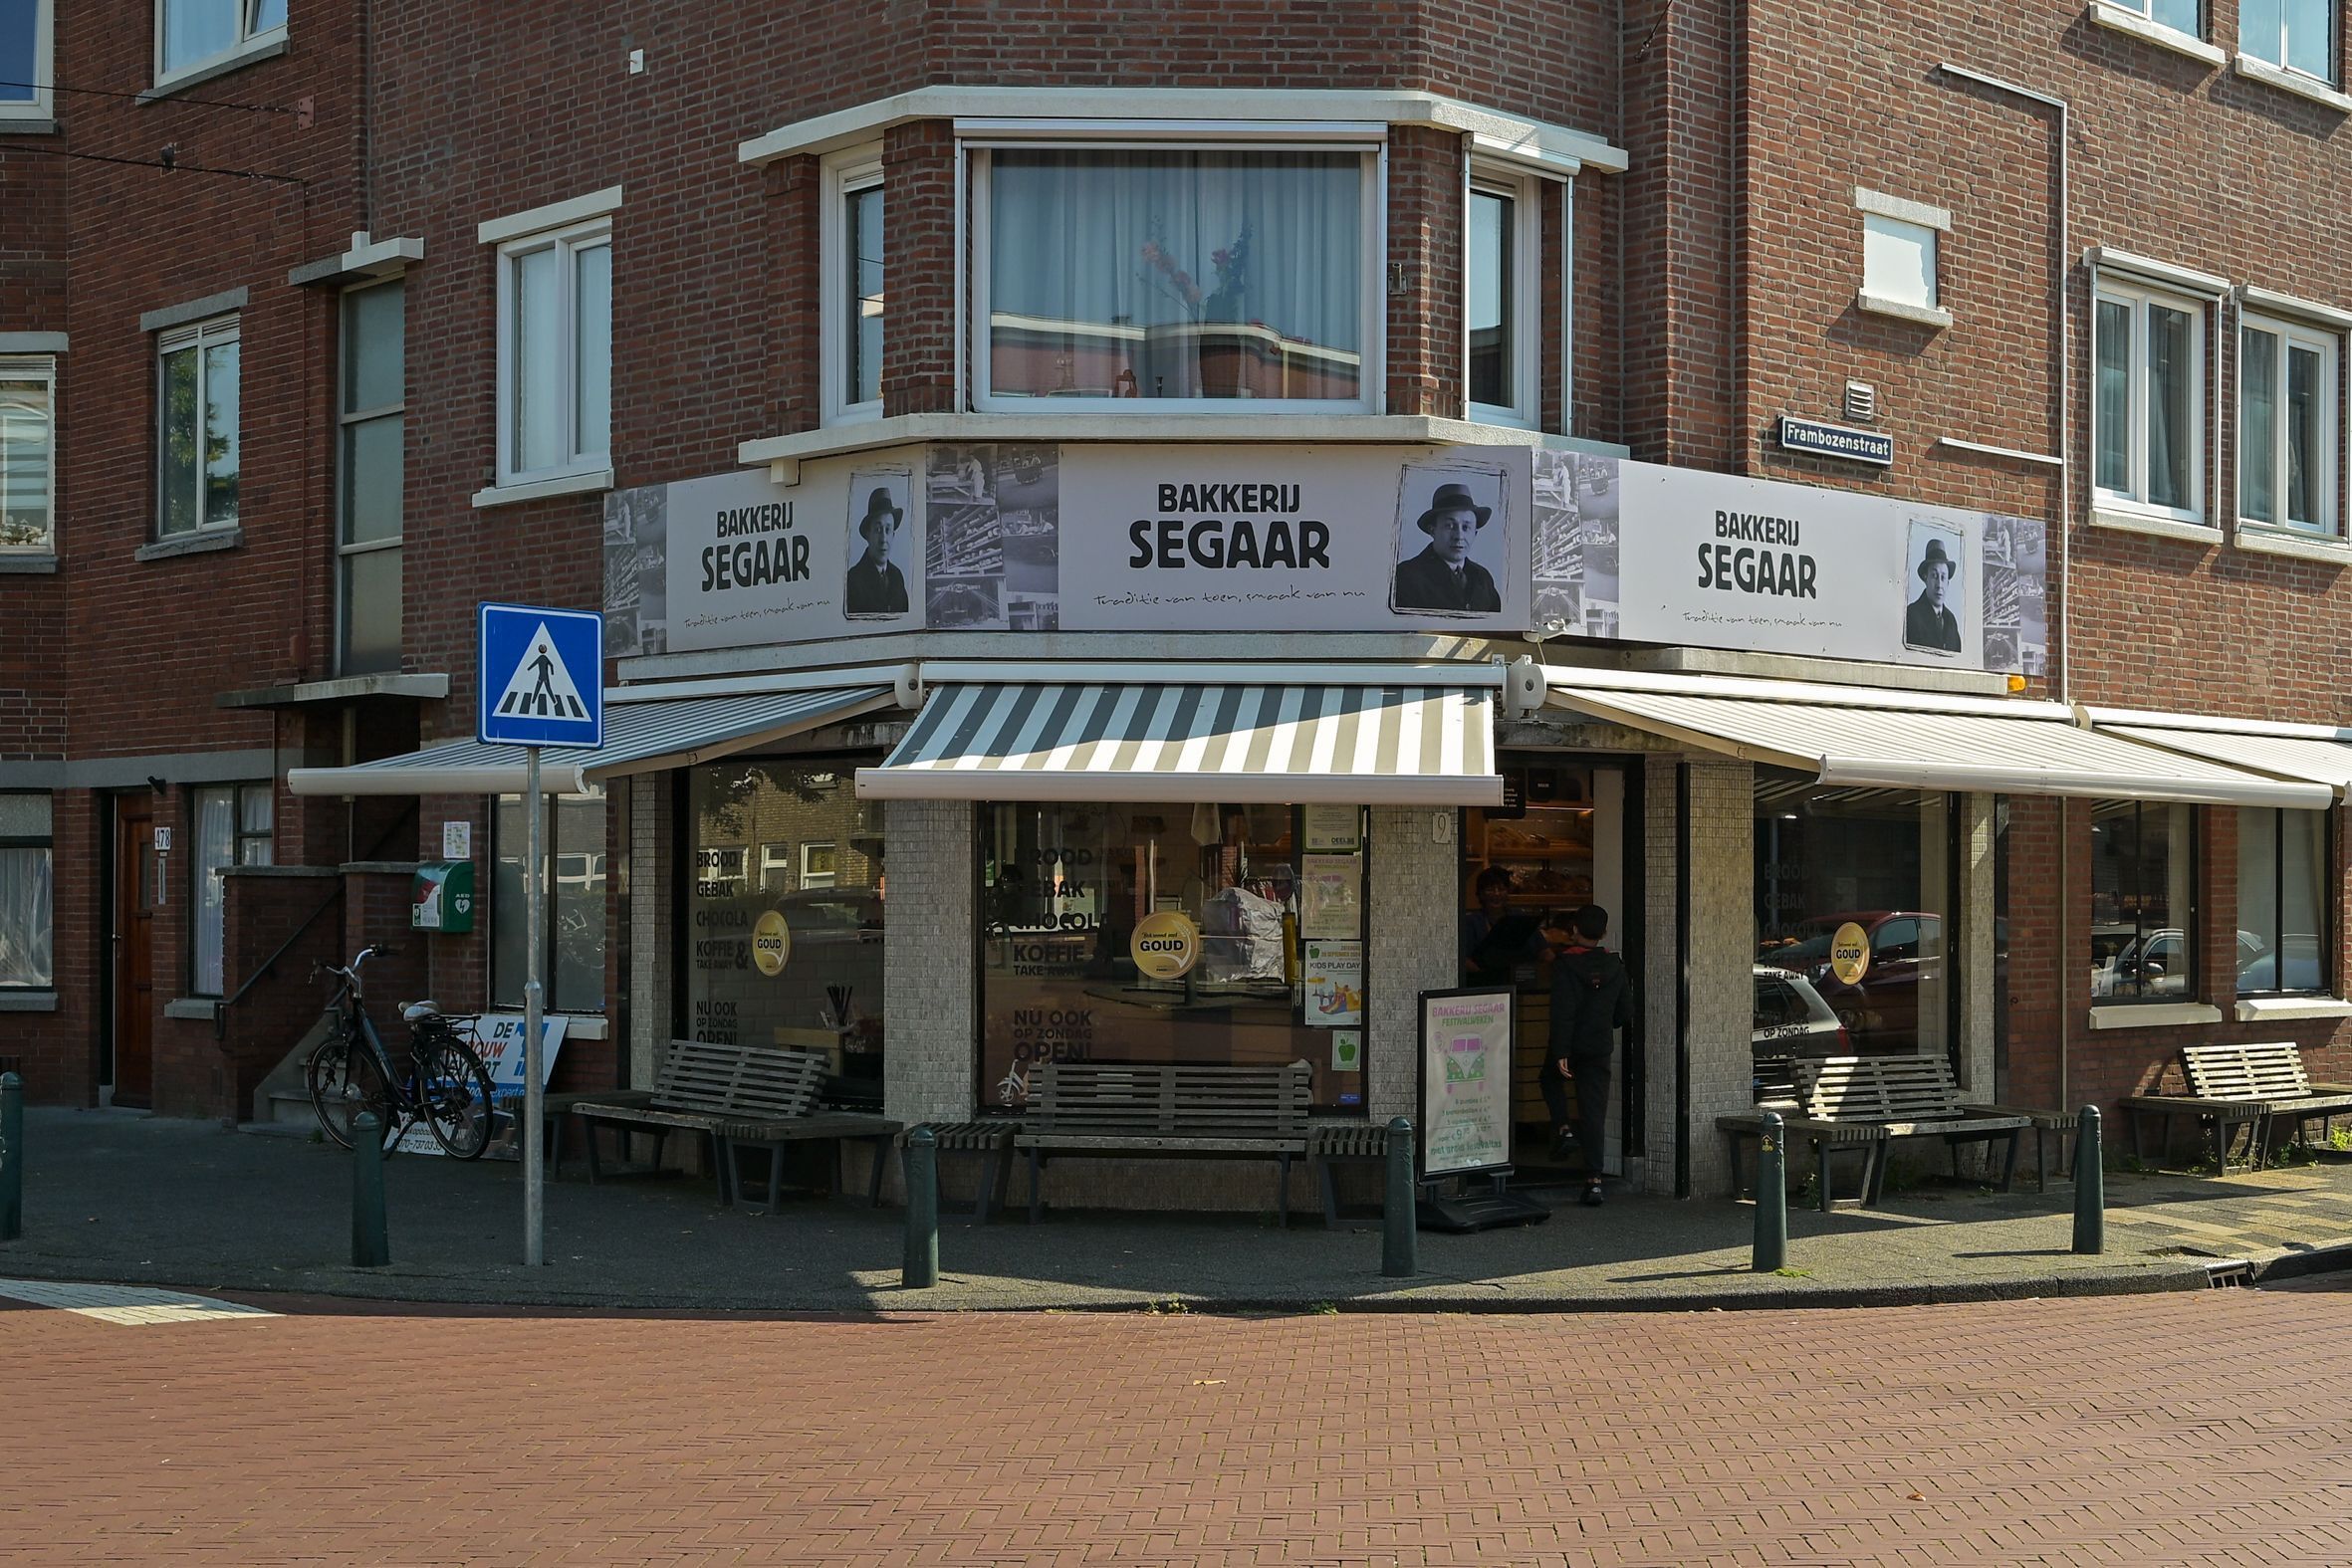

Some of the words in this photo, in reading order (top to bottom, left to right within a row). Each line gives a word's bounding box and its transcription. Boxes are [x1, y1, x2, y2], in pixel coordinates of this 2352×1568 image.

[1787, 424, 1888, 456] Frambozenstraat
[1158, 484, 1300, 513] BAKKERIJ
[716, 501, 793, 538] BAKKERIJ
[1715, 510, 1799, 547] BAKKERIJ
[1129, 520, 1330, 568] SEGAAR
[701, 535, 810, 592] SEGAAR
[1698, 543, 1816, 599] SEGAAR
[1094, 591, 1159, 606] Traditie
[1203, 591, 1242, 603] toen,
[1246, 584, 1300, 601] smaak
[1306, 590, 1336, 599] van
[1683, 609, 1723, 624] Traditie
[1750, 613, 1772, 627] toen,
[1773, 612, 1806, 627] smaak
[156, 830, 170, 848] 478
[697, 852, 737, 868] BROOD
[697, 882, 734, 897] GEBAK
[697, 911, 748, 927] CHOCOLA
[697, 941, 734, 957] KOFFIE
[757, 939, 782, 949] GOUD
[1140, 940, 1184, 952] GOUD
[1014, 945, 1084, 962] KOFFIE
[1836, 949, 1861, 959] GOUD
[1014, 966, 1044, 976] TAKE
[697, 1002, 711, 1015] NU
[714, 1002, 737, 1016] OOK
[1433, 1005, 1472, 1016] BAKKERIJ
[1474, 1003, 1505, 1014] SEGAAR
[697, 1018, 706, 1027] OP
[1014, 1010, 1043, 1025] NU
[1049, 1010, 1091, 1025] OOK
[494, 1022, 515, 1037] DE
[1014, 1029, 1033, 1039] OP
[1037, 1029, 1092, 1039] ZONDAG
[1764, 1029, 1774, 1038] OP
[1777, 1026, 1809, 1037] ZONDAG
[1014, 1042, 1091, 1061] OPEN!
